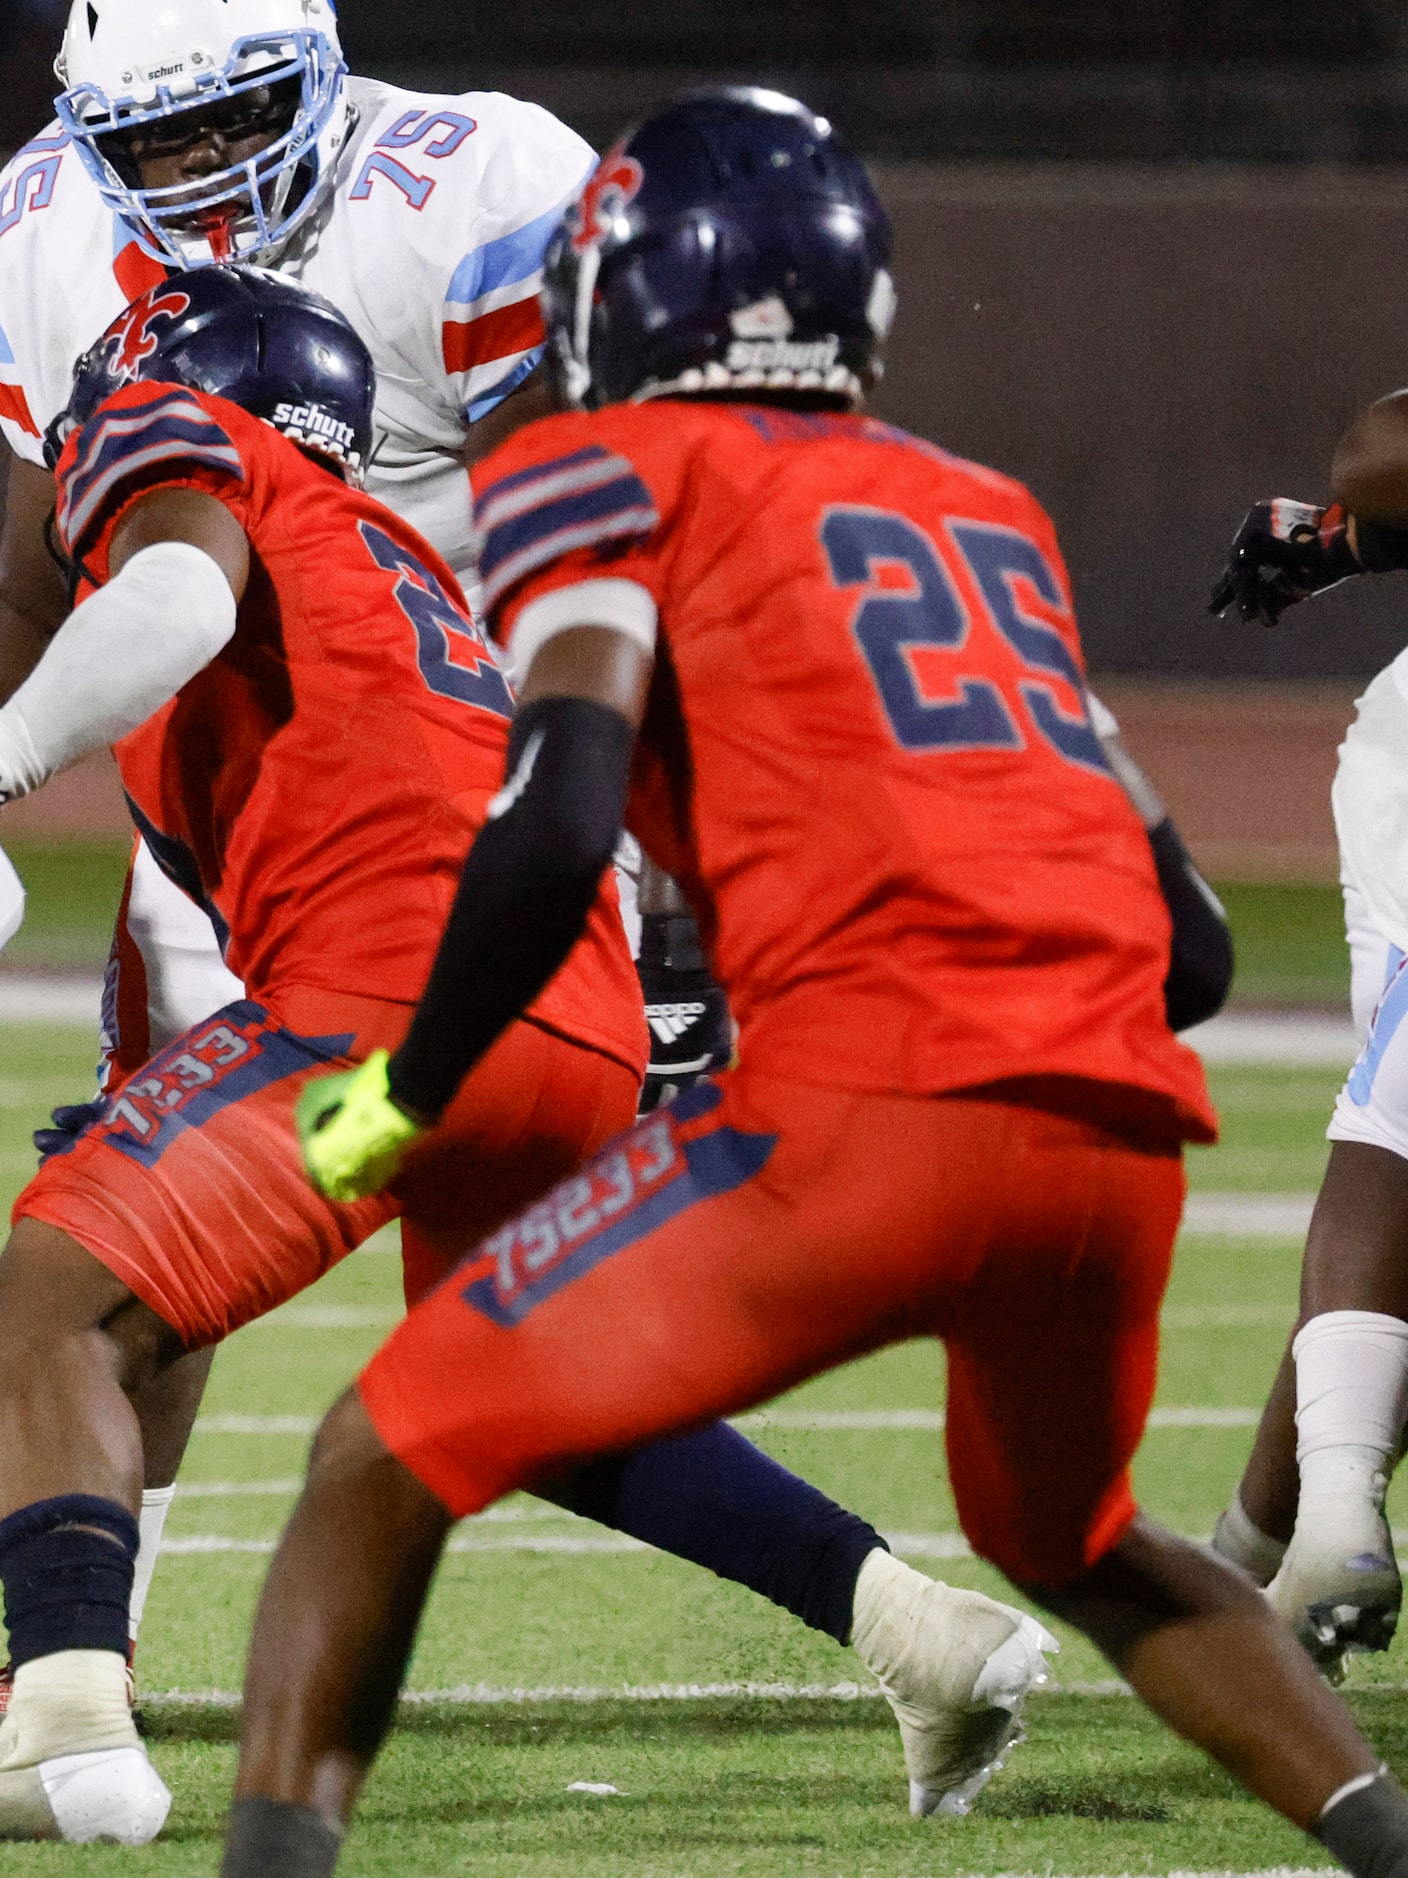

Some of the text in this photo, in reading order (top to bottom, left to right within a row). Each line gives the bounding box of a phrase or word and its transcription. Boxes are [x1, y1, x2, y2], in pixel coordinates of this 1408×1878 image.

[147, 61, 184, 80] schutt
[349, 109, 478, 212] 75
[273, 401, 355, 449] schutt
[818, 501, 1116, 778] 25
[483, 1118, 677, 1292] 75233
